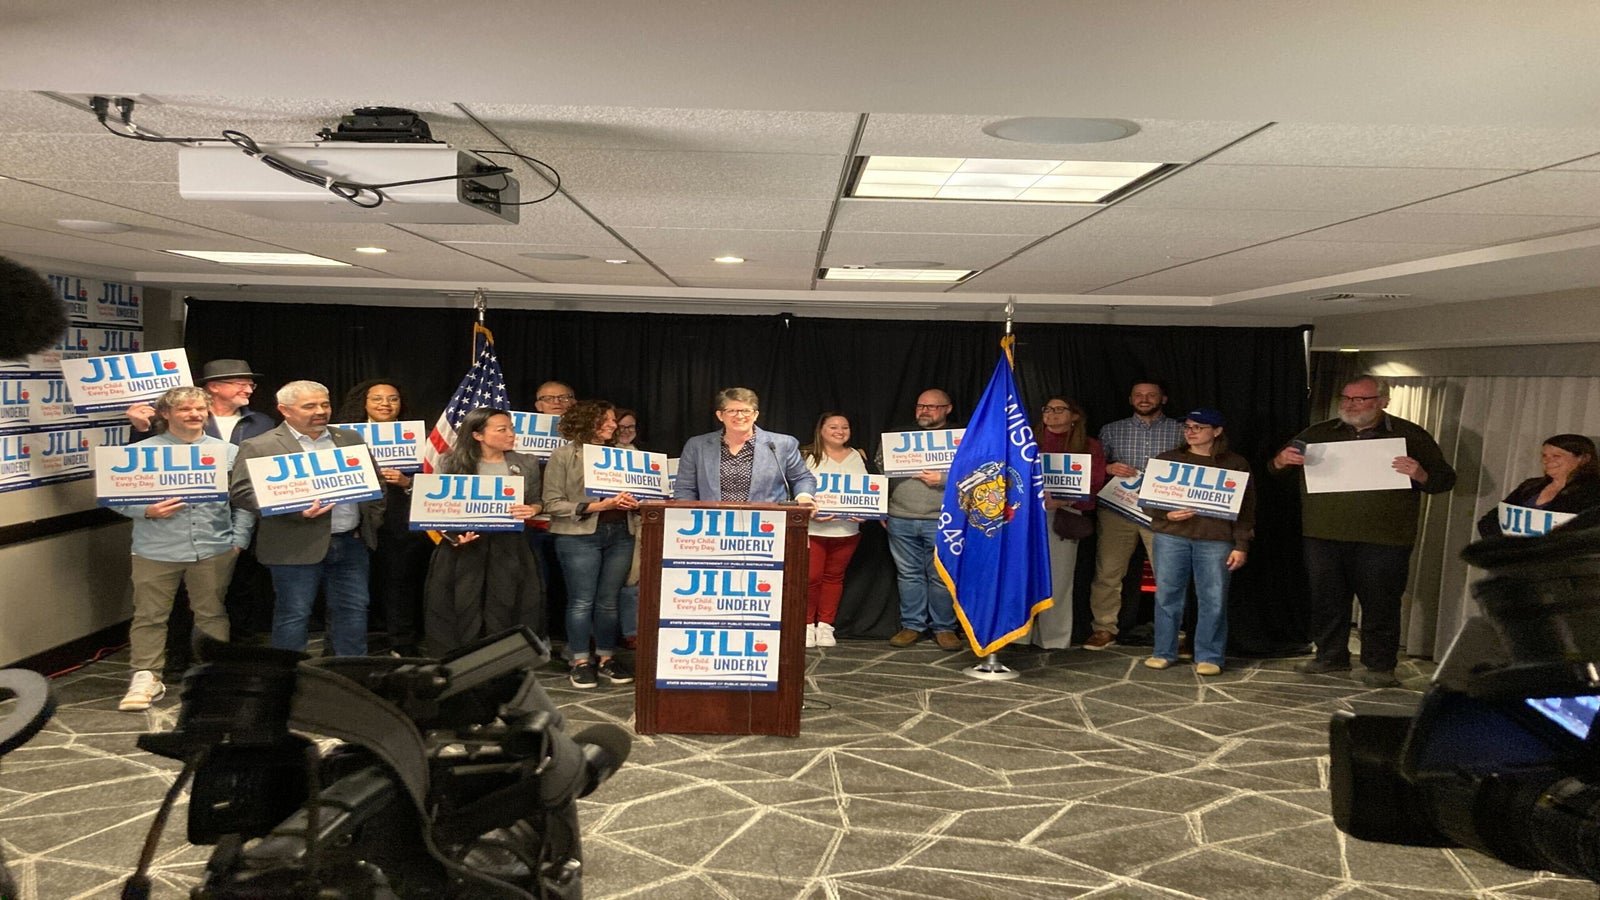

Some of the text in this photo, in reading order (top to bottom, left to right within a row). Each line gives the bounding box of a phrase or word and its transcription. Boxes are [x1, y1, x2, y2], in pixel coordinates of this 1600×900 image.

[98, 283, 139, 307] JILL
[98, 330, 140, 352] JILL
[80, 352, 180, 383] JILL
[2, 381, 30, 405] LL
[88, 389, 109, 397] Every
[127, 376, 181, 393] UNDERLY
[513, 413, 561, 437] ILL
[3, 436, 31, 461] LL
[42, 431, 88, 456] JILL
[892, 431, 958, 453] JILL
[110, 446, 216, 473] JILL
[265, 448, 363, 482] JILL
[593, 447, 661, 475] JILL
[925, 452, 955, 461] UNDER
[1043, 454, 1083, 475] LL
[159, 473, 216, 485] UNDERLY
[312, 472, 366, 490] UNDERLY
[425, 476, 516, 500] JILL
[625, 473, 661, 487] UNDERLY
[816, 473, 880, 494] JILL
[1152, 482, 1169, 491] Every
[1155, 463, 1236, 493] JILL
[273, 488, 294, 496] Every
[840, 495, 880, 506] UNDERLY
[1153, 488, 1170, 497] Every
[1187, 489, 1234, 504] UNDERLY
[677, 510, 775, 537] JILL
[720, 538, 774, 552] UNDERLY
[674, 570, 772, 597] JILL
[677, 604, 696, 612] Every
[717, 598, 771, 612] UNDERLY
[671, 630, 769, 657] JILL
[670, 657, 690, 665] Every
[674, 664, 693, 672] Every
[714, 658, 768, 672] UNDERLY
